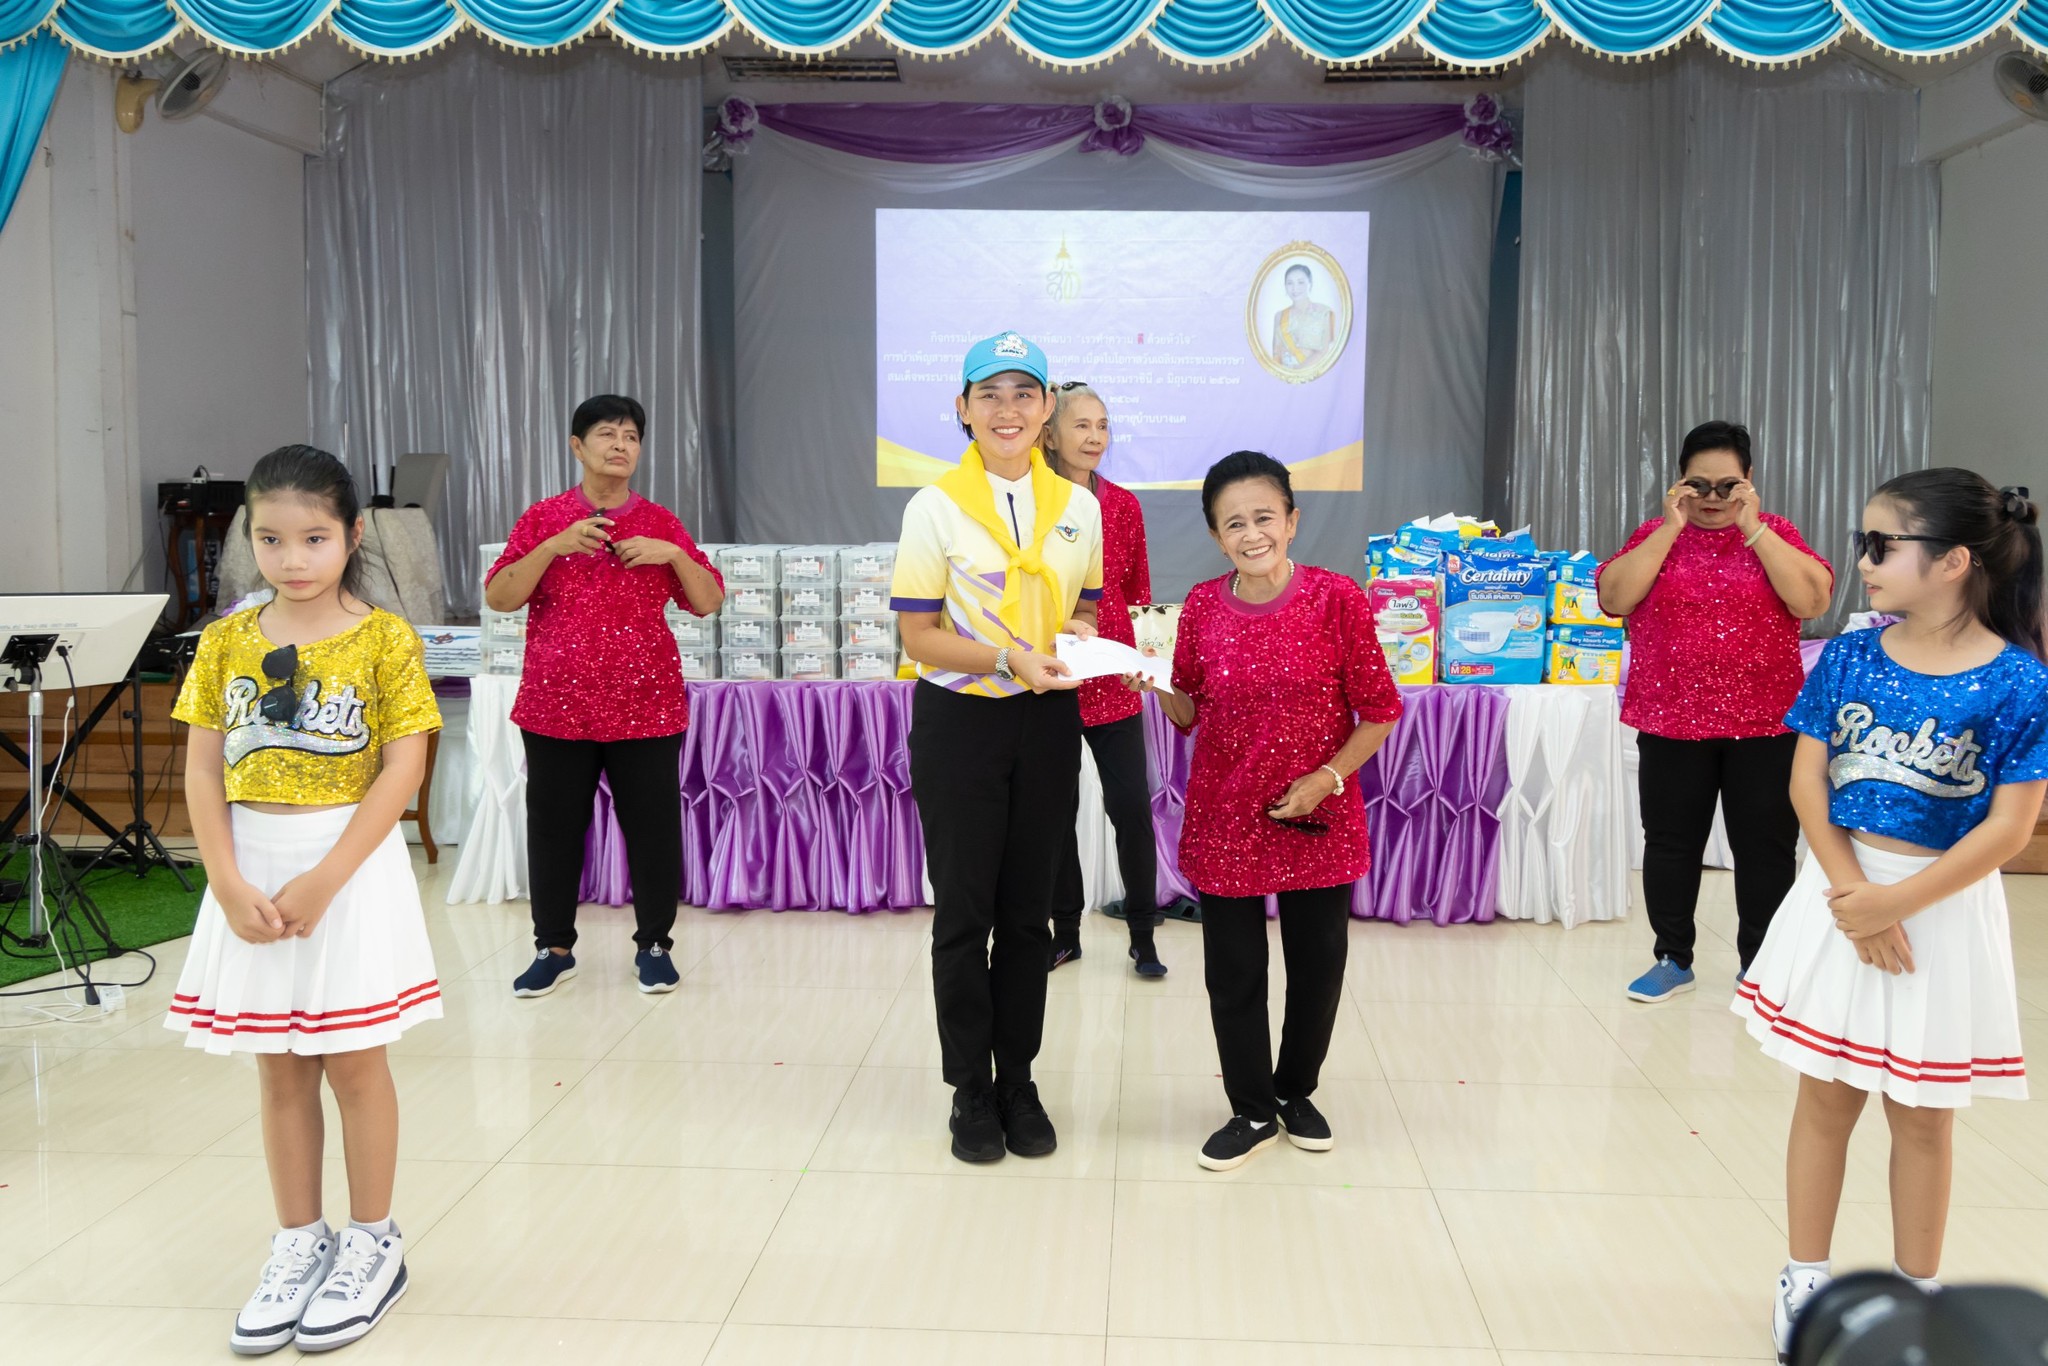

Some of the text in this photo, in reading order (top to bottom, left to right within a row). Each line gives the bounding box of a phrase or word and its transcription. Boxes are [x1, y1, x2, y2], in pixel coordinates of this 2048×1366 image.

[1461, 566, 1532, 586] Certainty
[1450, 666, 1472, 675] M 28
[1830, 701, 1982, 783] Rockets
